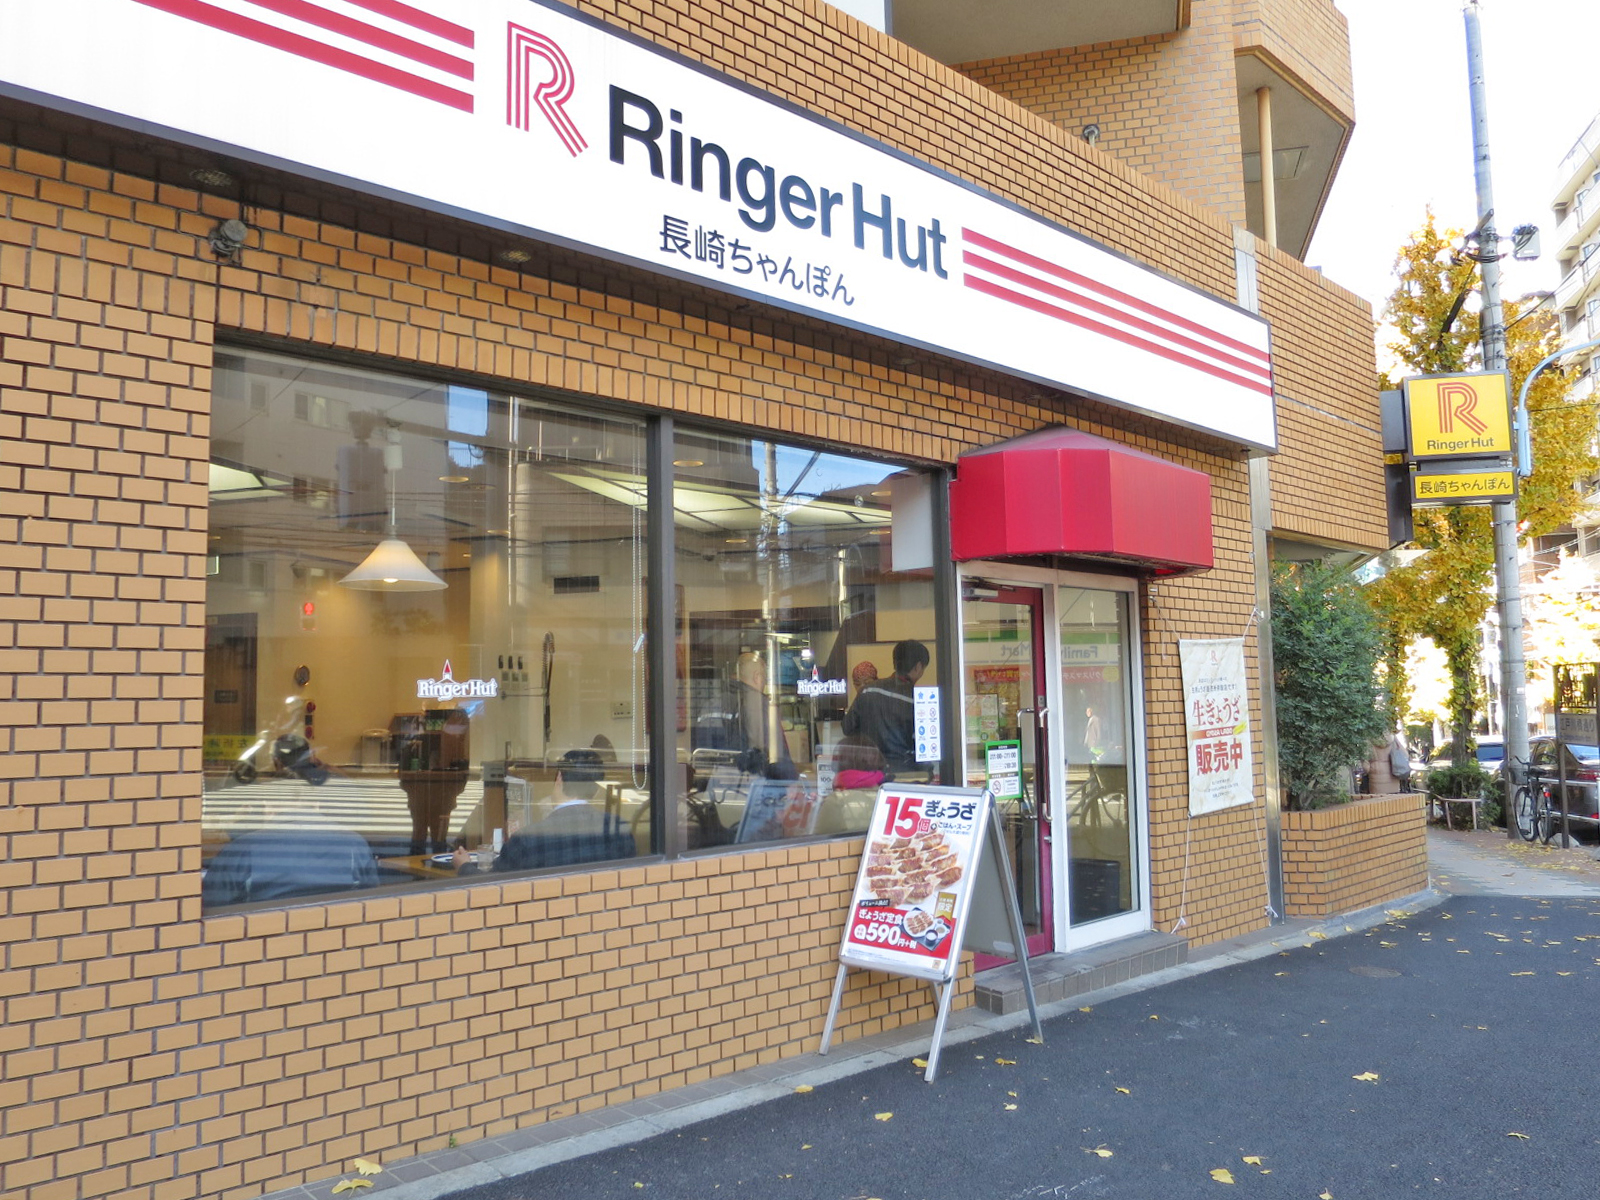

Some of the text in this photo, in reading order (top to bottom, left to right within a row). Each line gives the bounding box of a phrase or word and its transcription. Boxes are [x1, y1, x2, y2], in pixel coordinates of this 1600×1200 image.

[608, 84, 948, 280] Ringer Hut
[659, 215, 855, 306] 長崎ちゃんぽん
[1427, 437, 1494, 451] Ringer Hut
[1420, 478, 1510, 494] 長崎ちゃんぽん
[417, 678, 497, 701] Ringer Hut
[797, 679, 846, 697] Ringer Hut
[1192, 695, 1241, 727] 生ぎょうざ
[1196, 738, 1243, 776] 販売中
[925, 800, 977, 820] ぎょうざ
[859, 909, 903, 925] ぎょうざ定食
